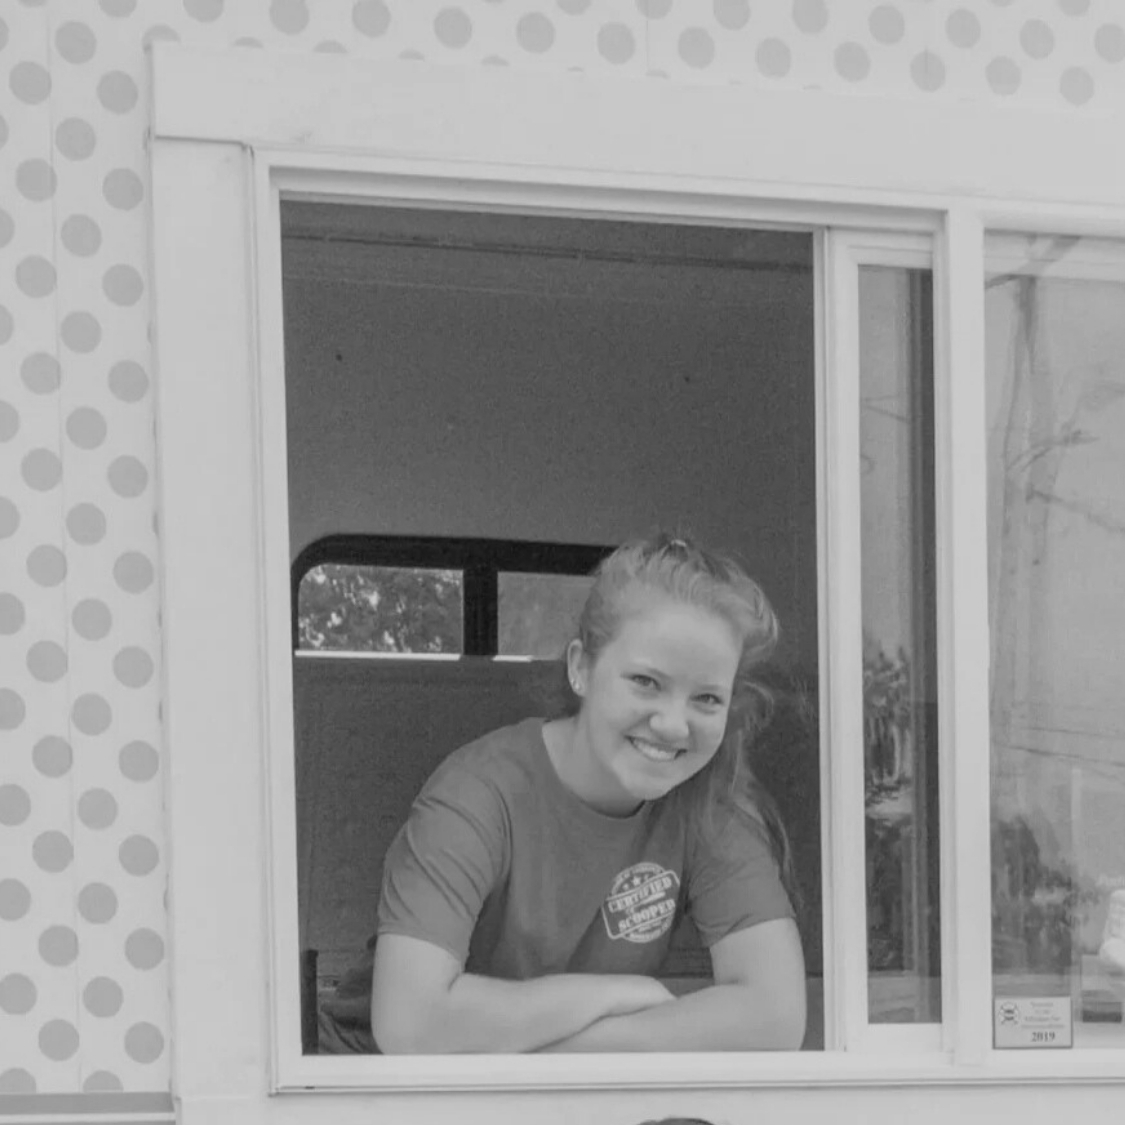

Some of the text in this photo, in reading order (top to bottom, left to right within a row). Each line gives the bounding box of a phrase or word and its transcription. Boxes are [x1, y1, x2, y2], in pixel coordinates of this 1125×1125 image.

[608, 875, 672, 914] CERTIFIED
[618, 898, 676, 932] SCOOPER
[1031, 1031, 1056, 1043] 2019
